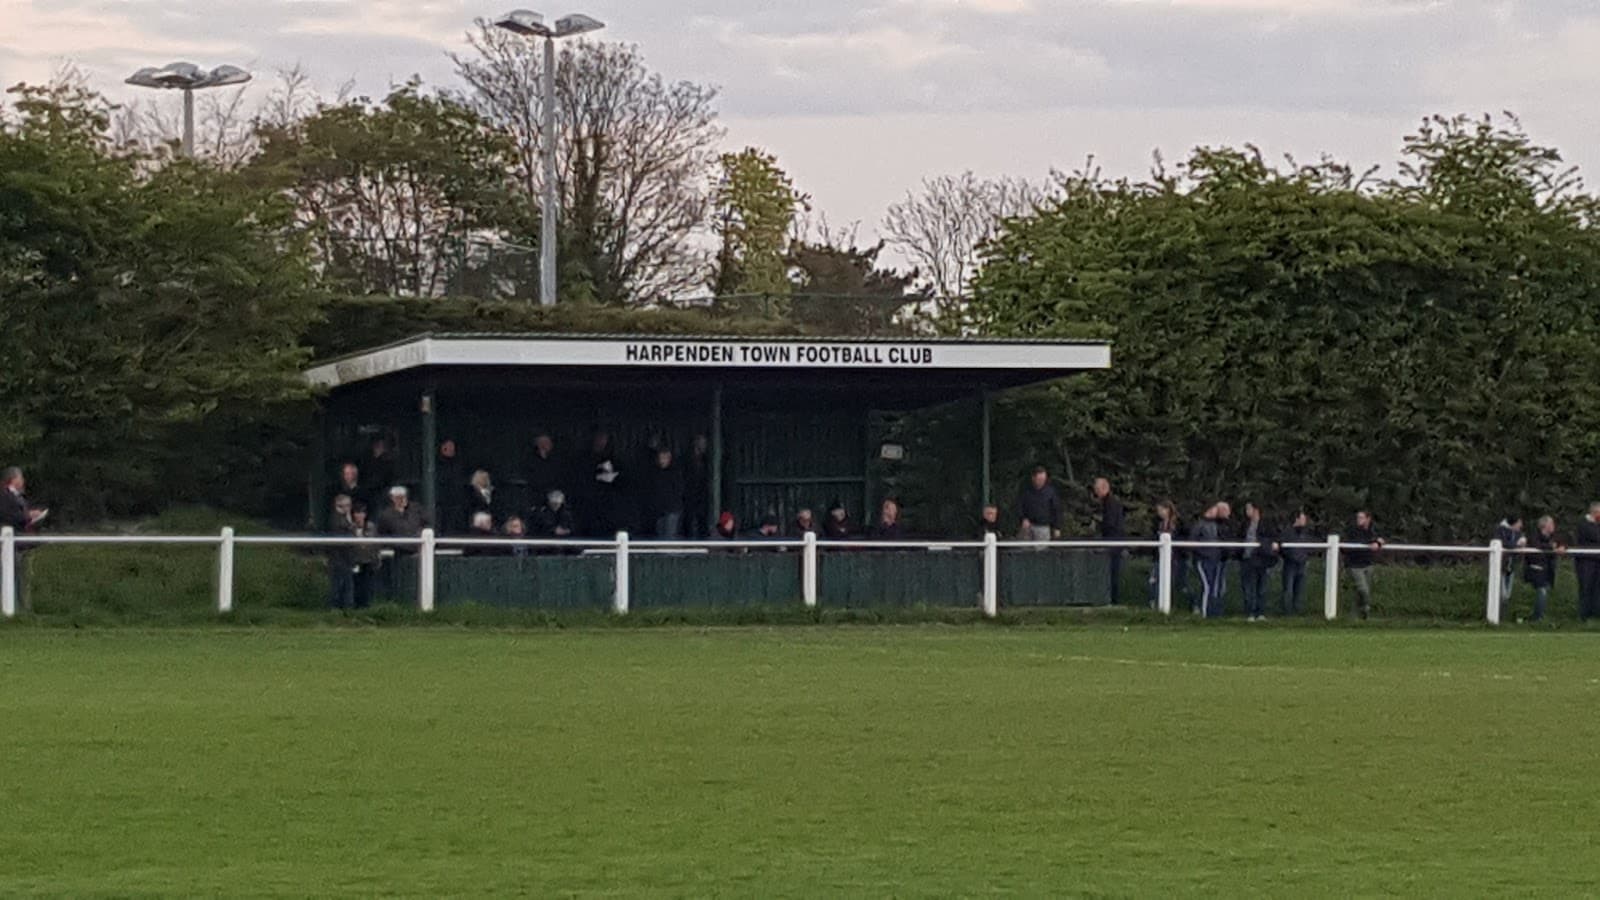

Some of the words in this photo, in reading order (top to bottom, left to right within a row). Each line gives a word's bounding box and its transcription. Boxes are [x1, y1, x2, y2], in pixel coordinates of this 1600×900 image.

[626, 344, 734, 362] HARPENDEN
[740, 345, 791, 363] TOWN
[797, 346, 883, 364] FOOTBALL
[888, 346, 933, 364] CLUB
